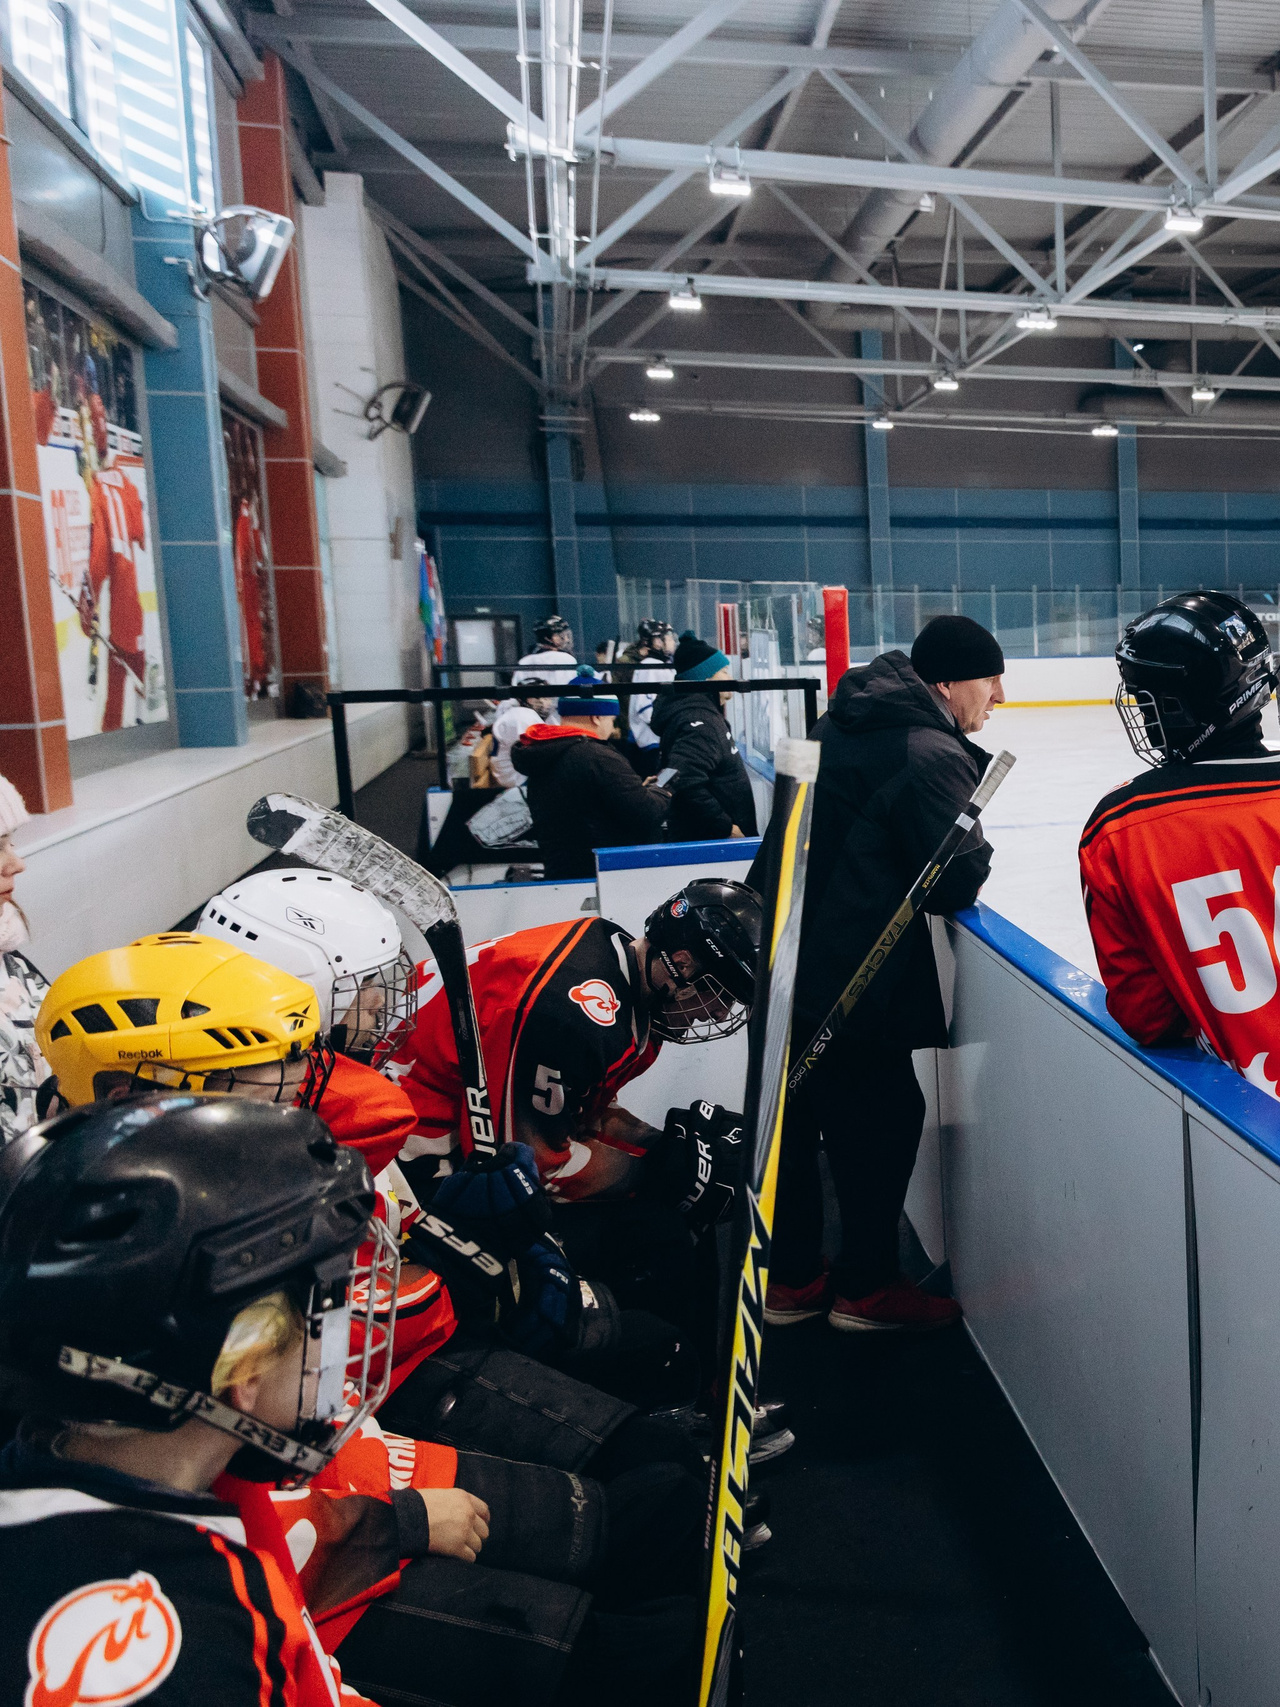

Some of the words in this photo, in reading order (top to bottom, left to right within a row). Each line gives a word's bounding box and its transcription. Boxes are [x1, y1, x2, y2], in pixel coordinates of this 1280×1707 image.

[1229, 679, 1263, 715] PRIME
[1188, 723, 1216, 753] PRIME
[705, 937, 724, 958] CCM
[848, 917, 911, 1000] TACKS
[118, 1049, 163, 1060] Reebok
[531, 1064, 565, 1116] 5
[788, 1065, 807, 1089] PRO
